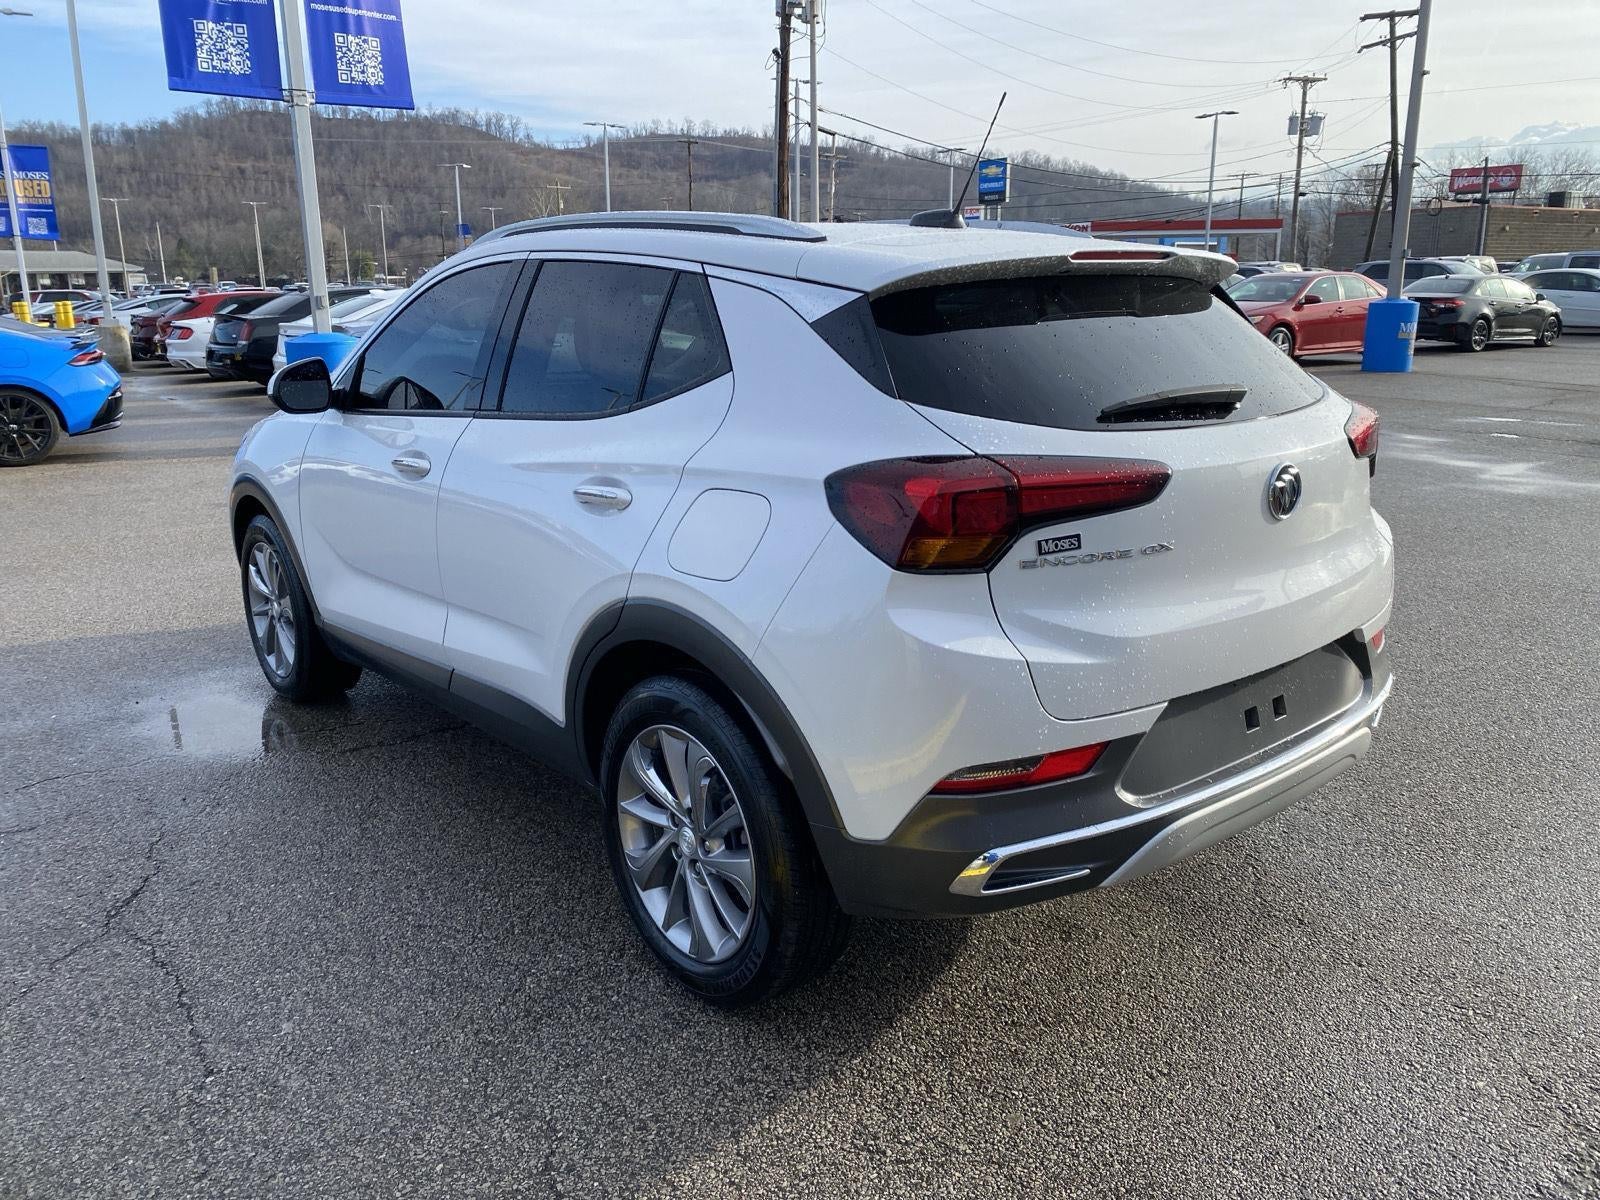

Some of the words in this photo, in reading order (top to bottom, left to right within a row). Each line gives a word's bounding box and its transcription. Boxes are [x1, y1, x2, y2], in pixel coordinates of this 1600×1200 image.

[13, 170, 49, 180] MOSES
[14, 179, 51, 197] USED
[1040, 537, 1079, 554] MOSES
[1019, 549, 1135, 569] ENCORE
[1141, 542, 1174, 555] GX
